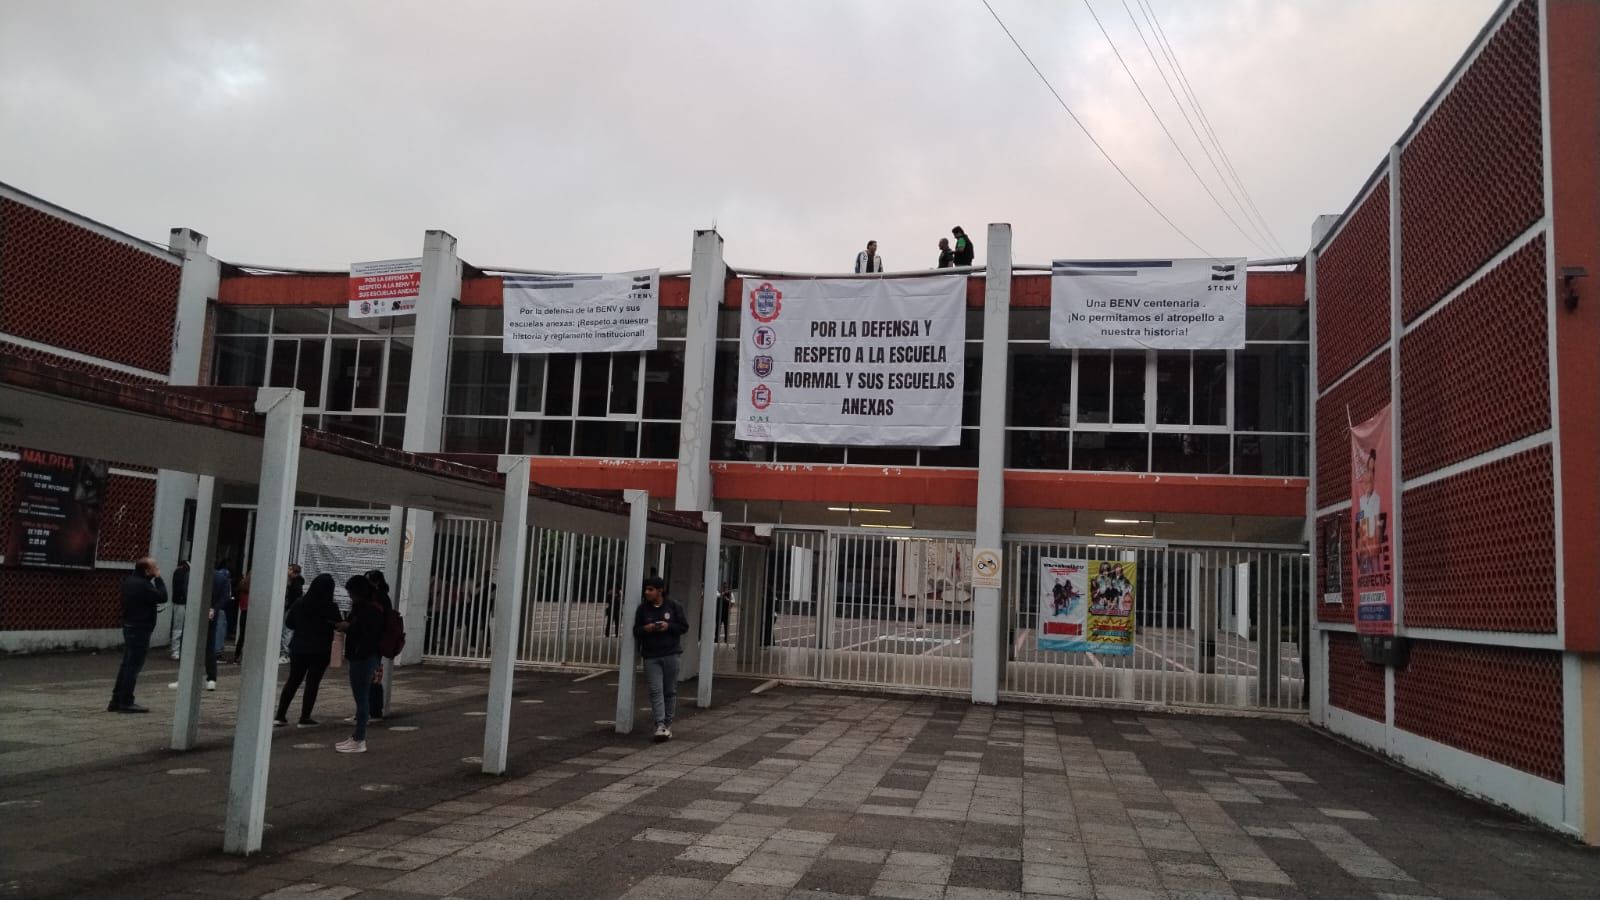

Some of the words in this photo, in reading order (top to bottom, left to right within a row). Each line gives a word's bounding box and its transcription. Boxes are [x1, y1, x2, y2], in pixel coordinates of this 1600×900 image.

[1086, 299, 1107, 308] Una
[1109, 298, 1141, 308] BENV
[1143, 298, 1200, 308] centenaria
[536, 306, 542, 315] la
[544, 306, 574, 315] defensa
[576, 306, 585, 314] de
[587, 306, 594, 314] la
[596, 305, 617, 314] BENV
[1068, 313, 1086, 322] ¡No
[1089, 313, 1151, 323] permitamos
[1154, 313, 1164, 322] el
[1166, 313, 1214, 323] atropello
[577, 319, 611, 328] ¡Respeto
[810, 321, 836, 338] POR
[840, 321, 857, 338] LA
[862, 320, 919, 337] DEFENSA
[923, 320, 932, 337] Y
[1101, 328, 1141, 336] nuestra
[1144, 327, 1188, 336] historia!
[512, 332, 542, 340] historia
[550, 331, 593, 340] reglamento
[594, 330, 645, 339] institucional!
[794, 346, 850, 363] RESPETO
[855, 346, 864, 362] A
[868, 346, 885, 363] LA
[889, 346, 947, 363] ESCUELA
[784, 372, 841, 389] NORMAL
[845, 373, 854, 389] Y
[858, 372, 884, 389] SUS
[888, 372, 955, 390] ESCUELAS
[841, 398, 894, 416] ANEXAS
[24, 449, 75, 471] MALDITA
